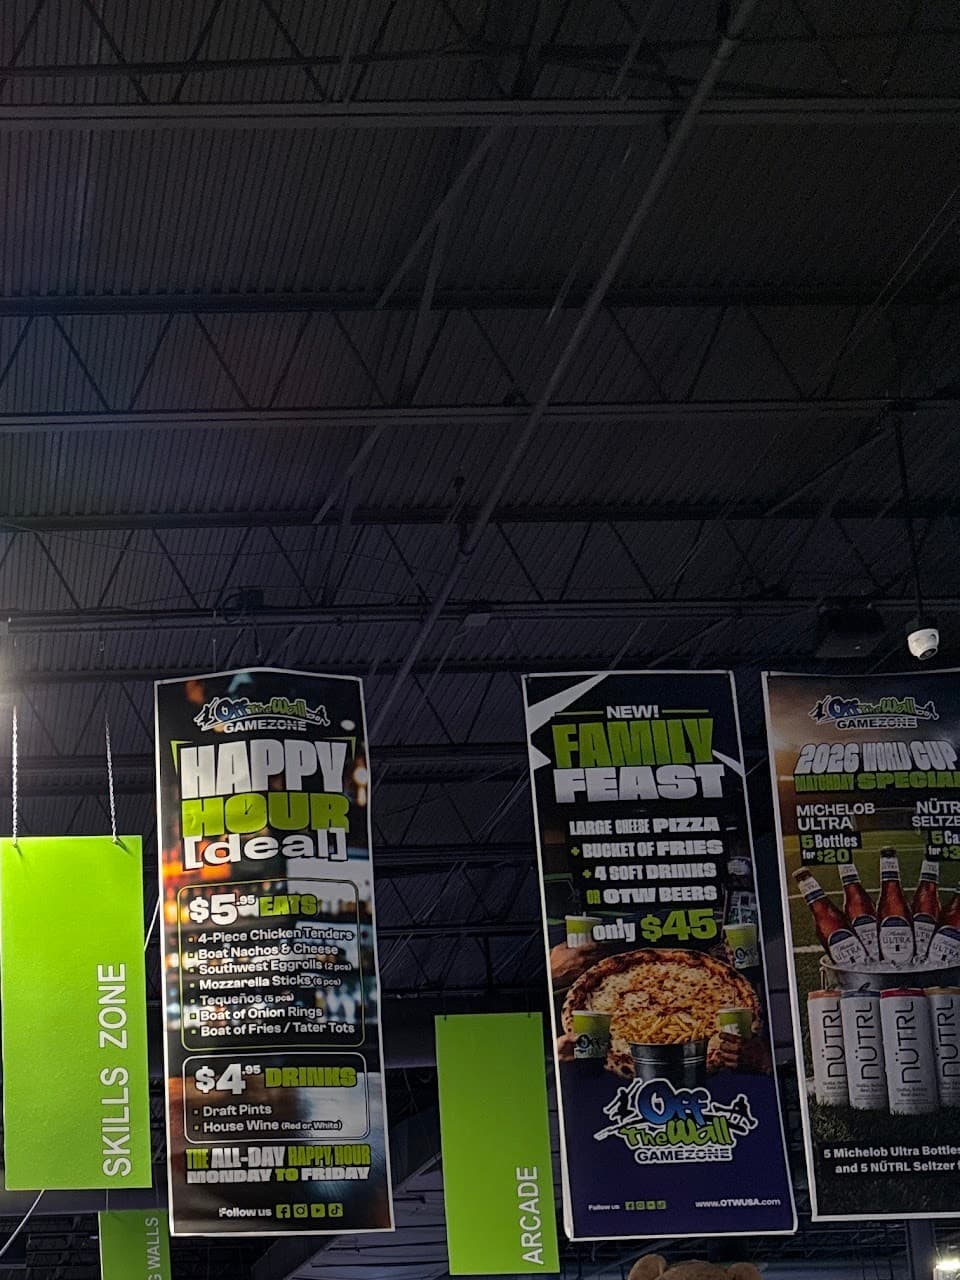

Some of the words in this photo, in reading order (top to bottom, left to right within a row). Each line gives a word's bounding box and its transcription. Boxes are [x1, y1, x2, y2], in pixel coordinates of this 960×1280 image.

[606, 705, 660, 719] NEW!
[223, 719, 308, 734] GAMEZONE
[836, 717, 918, 730] GAMEZONE
[551, 717, 714, 768] FAMILY
[794, 743, 860, 774] 2026
[862, 741, 913, 772] WORLD
[909, 740, 958, 771] CUP
[180, 738, 348, 800] HAPPY
[553, 763, 725, 803] FEAST
[796, 803, 876, 817] MICHELOB
[916, 798, 960, 814] NÜTR
[182, 792, 350, 838] HOUR
[797, 816, 854, 831] ULTRA
[911, 816, 960, 828] SELTZE
[569, 820, 613, 836] LARGE
[615, 819, 650, 834] CHEESE
[653, 817, 721, 833] PIZZA
[582, 842, 636, 858] BUCKET
[637, 842, 655, 857] OF
[656, 840, 724, 856] FRIES
[801, 834, 814, 849] 5
[815, 833, 858, 848] Bottles
[802, 850, 815, 860] for
[817, 848, 850, 863] $20
[594, 866, 607, 881] 4
[609, 865, 643, 881] SOFT
[645, 863, 717, 879] DRINKS
[586, 889, 601, 904] OR
[603, 888, 656, 904] OTW
[659, 885, 717, 902] BEERS
[259, 893, 318, 916] EATS
[592, 918, 636, 942] only
[641, 908, 717, 942] $45
[198, 930, 248, 944] 4-Piece
[250, 928, 302, 942] Chicken
[303, 927, 353, 940] Tenders
[198, 948, 229, 960] Boat
[230, 945, 279, 958] Nachos
[280, 943, 291, 956] &
[293, 943, 338, 955] Cheese
[199, 961, 269, 975] Southwest
[271, 958, 322, 972] Eggrolls
[200, 976, 270, 990] Mozzarella
[272, 974, 312, 987] Sticks
[97, 962, 128, 1049] ZONE
[200, 992, 262, 1006] Tequeños
[200, 1009, 231, 1021] Boat
[232, 1008, 246, 1020] of
[248, 1008, 285, 1019] Onion
[288, 1006, 323, 1018] Rings
[201, 1025, 231, 1037] Boat
[233, 1024, 246, 1036] of
[248, 1023, 282, 1035] Fries
[292, 1022, 327, 1033] Tater
[328, 1021, 355, 1033] Tots
[265, 1066, 358, 1088] DRINKS
[203, 1104, 237, 1117] Draft
[239, 1104, 273, 1116] Pints
[639, 1083, 710, 1125] Off
[99, 1067, 132, 1178] SKILLS
[203, 1121, 244, 1132] House
[246, 1119, 279, 1131] Wine
[281, 1121, 301, 1130] (Red
[313, 1120, 342, 1131] White)
[666, 1117, 733, 1146] Wall
[186, 1148, 209, 1169] THE
[211, 1146, 286, 1169] ALL-DAY
[287, 1145, 333, 1168] HAPPY
[333, 1143, 371, 1167] HOUR
[636, 1148, 732, 1163] GAMEZONE
[823, 1149, 832, 1159] 5
[833, 1146, 889, 1159] Michelob
[890, 1145, 920, 1157] Ultra
[921, 1145, 960, 1156] Bottles
[187, 1168, 272, 1184] MONDAY
[275, 1168, 299, 1182] TO
[301, 1166, 371, 1181] FRIDAY
[835, 1163, 859, 1174] and
[860, 1163, 869, 1173] 5
[870, 1160, 912, 1172] NÜTRL
[913, 1160, 956, 1171] Seltzer
[695, 1198, 781, 1208] www.OTWUSA.com
[218, 1207, 257, 1217] Follow
[258, 1208, 272, 1217] us
[516, 1166, 544, 1265] ARCADE
[144, 1216, 162, 1271] WALLS
